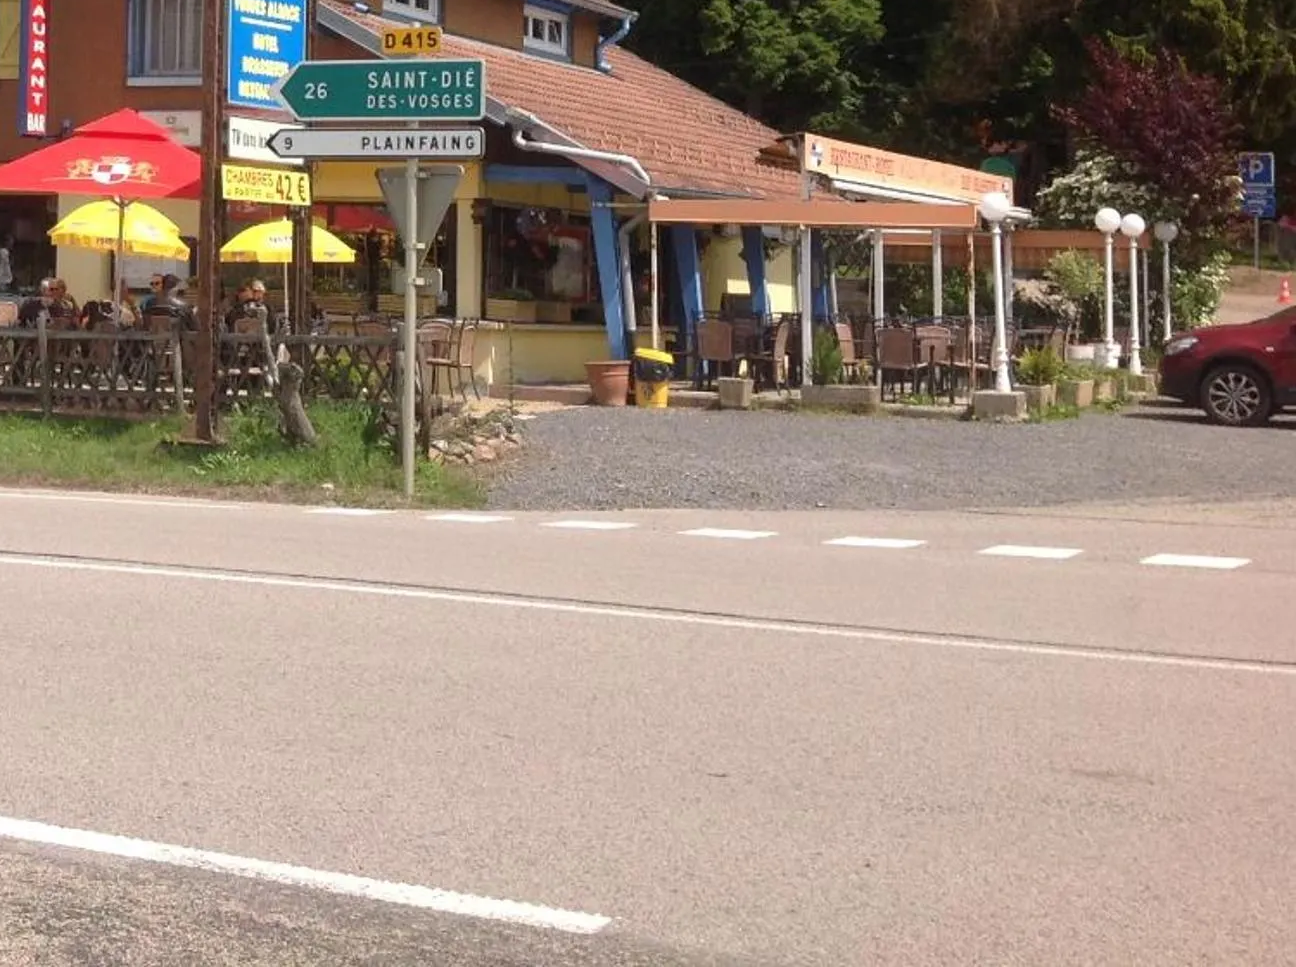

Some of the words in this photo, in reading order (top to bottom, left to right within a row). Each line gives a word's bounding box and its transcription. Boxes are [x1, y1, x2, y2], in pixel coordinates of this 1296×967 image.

[385, 34, 396, 49] D
[402, 32, 438, 49] 415
[304, 84, 328, 100] 26
[367, 94, 474, 109] DES-VOSGES
[27, 113, 45, 131] BAR
[284, 137, 293, 150] 9
[362, 137, 475, 150] PLAINFAING
[1249, 160, 1264, 179] P
[276, 174, 293, 200] 42
[298, 175, 306, 202] €
